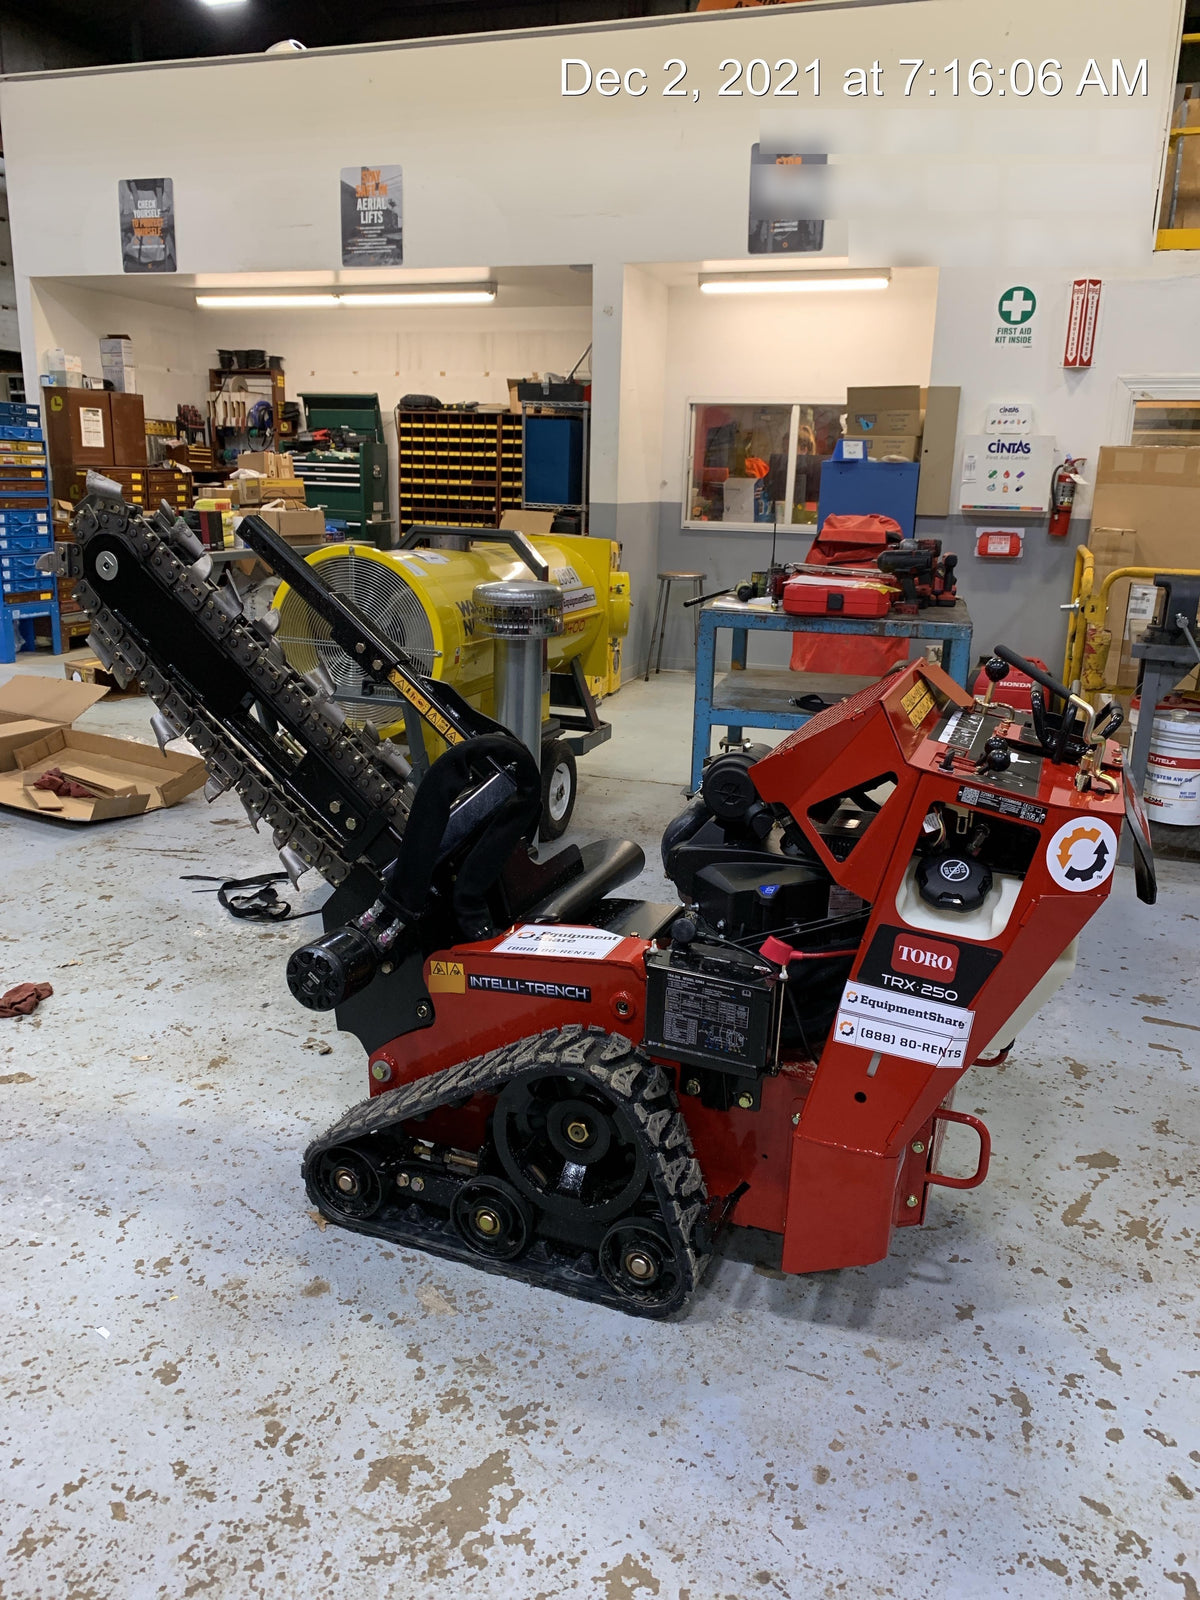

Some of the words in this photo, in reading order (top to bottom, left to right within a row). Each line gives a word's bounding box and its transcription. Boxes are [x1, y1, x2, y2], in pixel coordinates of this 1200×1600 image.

[137, 199, 156, 209] CHECK
[356, 197, 388, 211] AERIAL
[133, 208, 161, 218] YOURSELF
[360, 211, 384, 224] LIFTS
[996, 327, 1018, 335] FIRST
[1019, 327, 1032, 335] AID
[994, 336, 1007, 344] KIT
[1008, 336, 1032, 344] INSIDE
[999, 681, 1032, 689] HONDA
[541, 931, 620, 941] Equipment
[898, 945, 953, 971] TORO
[860, 994, 966, 1030] EquipmentShare
[860, 1027, 896, 1044] (888)
[899, 1037, 962, 1059] 80-RENTS
